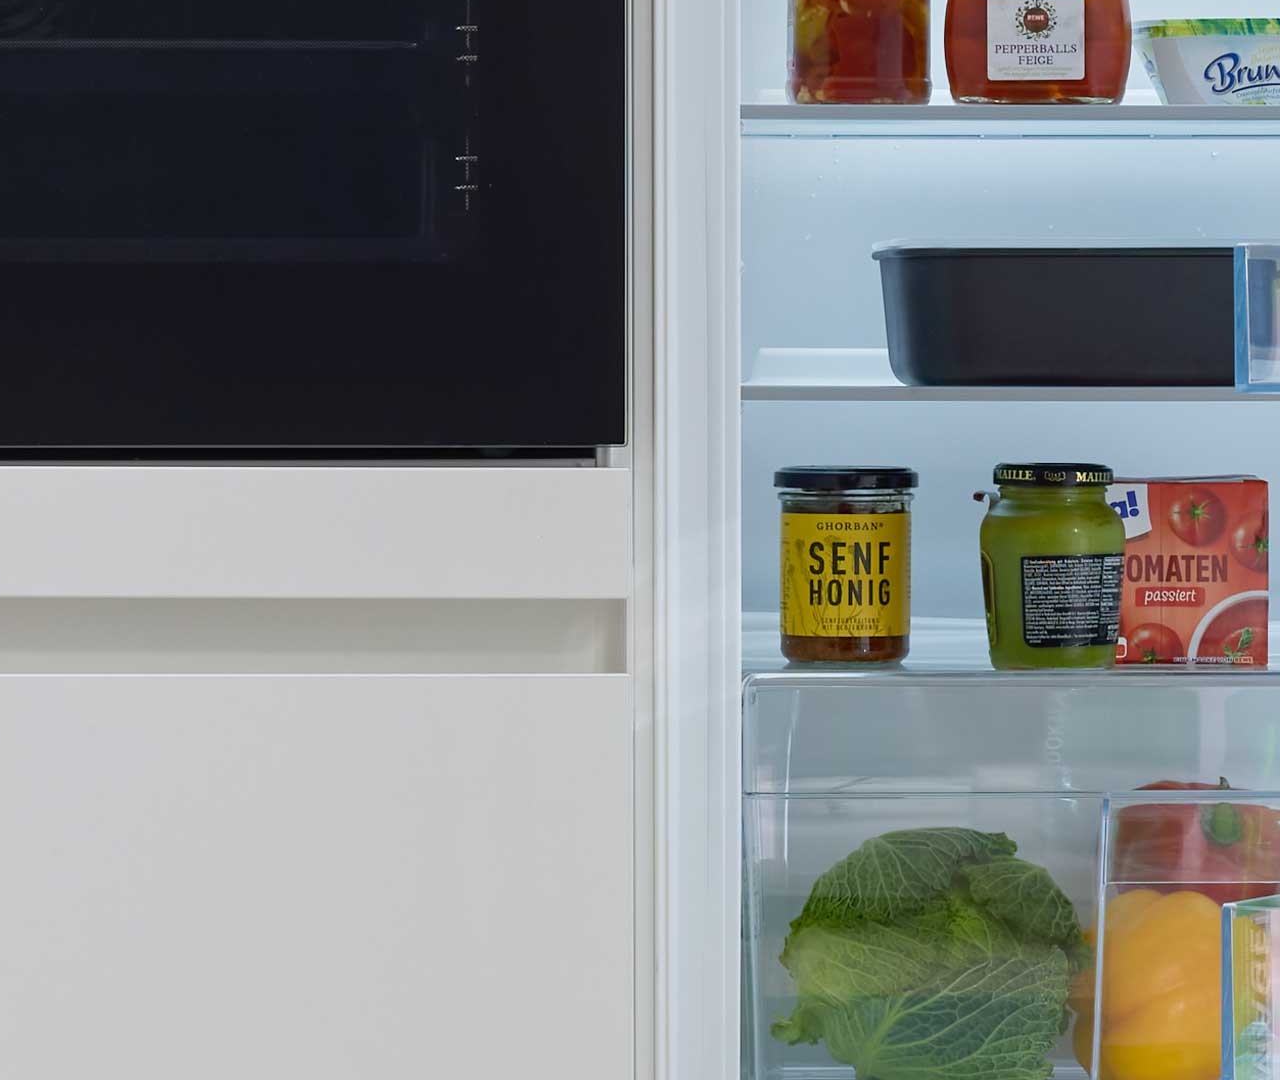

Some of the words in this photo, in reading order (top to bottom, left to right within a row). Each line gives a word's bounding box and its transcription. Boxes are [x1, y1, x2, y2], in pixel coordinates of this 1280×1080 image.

[995, 43, 1077, 54] PEPPERBALLS
[1018, 55, 1054, 65] FEIGE
[809, 541, 891, 575] SENF
[1124, 553, 1229, 583] OMATEN
[809, 578, 891, 606] HONIG
[1143, 589, 1197, 606] passiert
